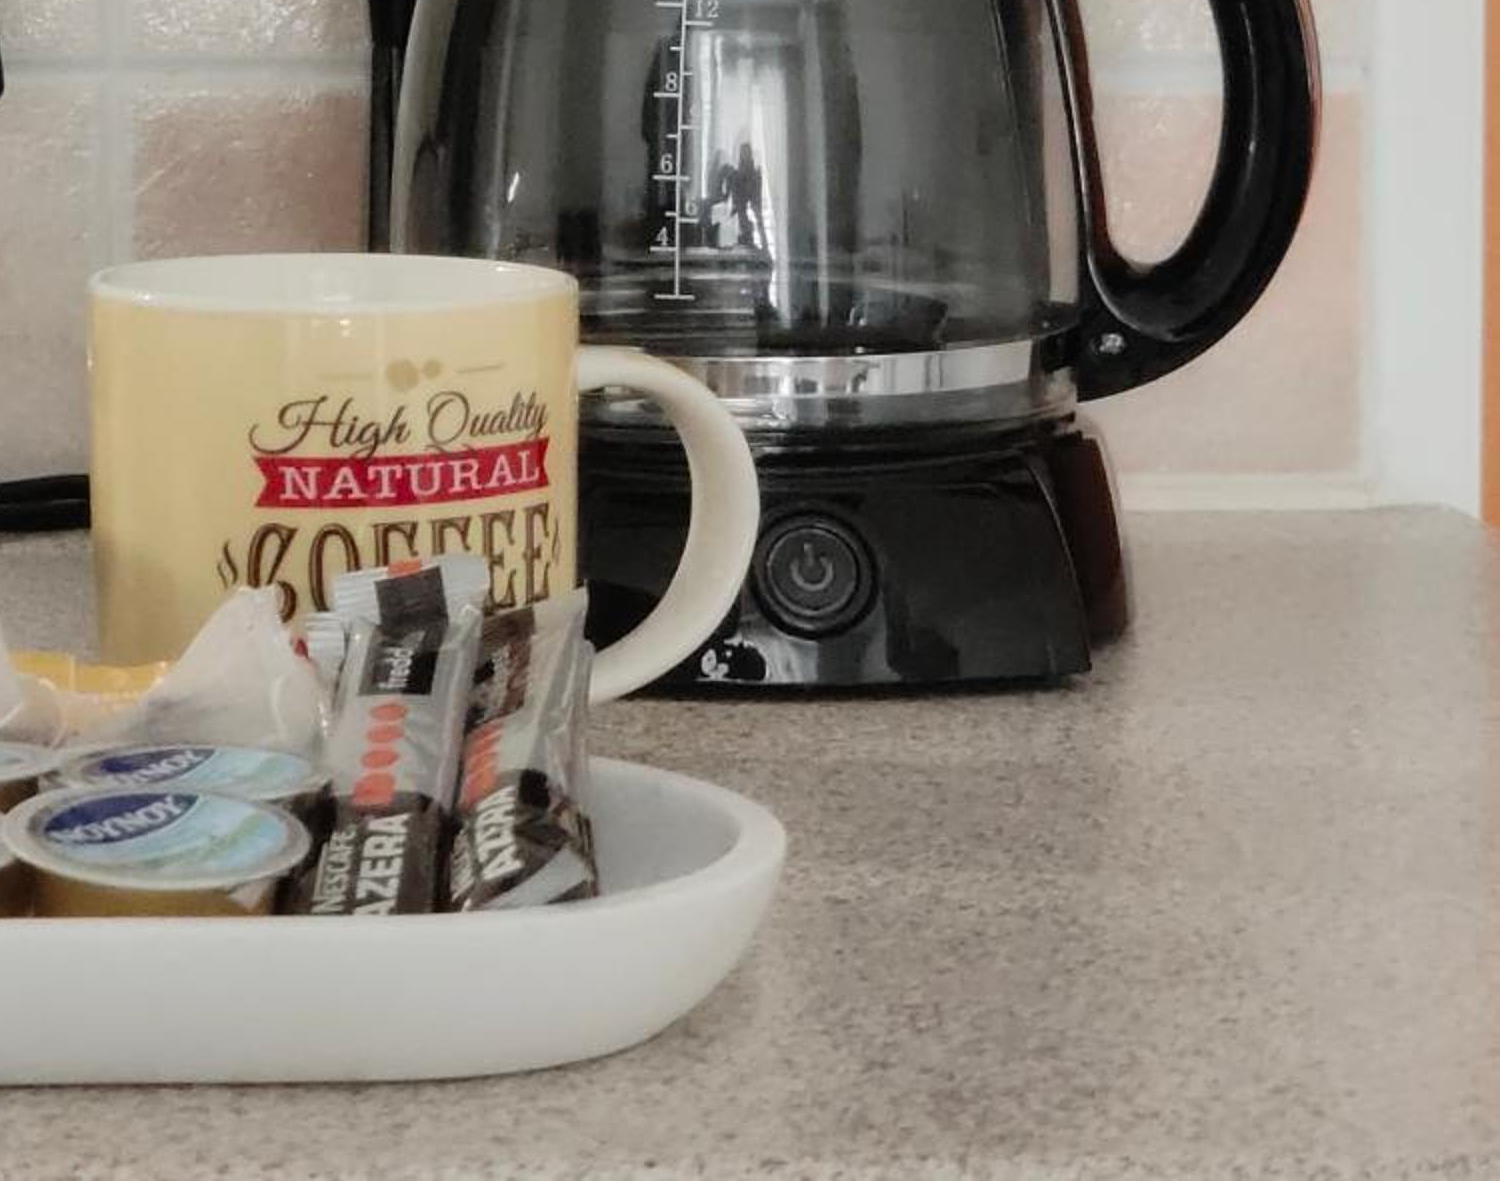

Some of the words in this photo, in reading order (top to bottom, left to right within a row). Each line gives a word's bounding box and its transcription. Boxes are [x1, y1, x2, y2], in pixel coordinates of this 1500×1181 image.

[665, 71, 678, 92] 8
[660, 152, 674, 173] 6
[655, 225, 669, 246] 4
[249, 395, 411, 460] High
[423, 390, 548, 453] Quality
[278, 450, 540, 501] NATURAL
